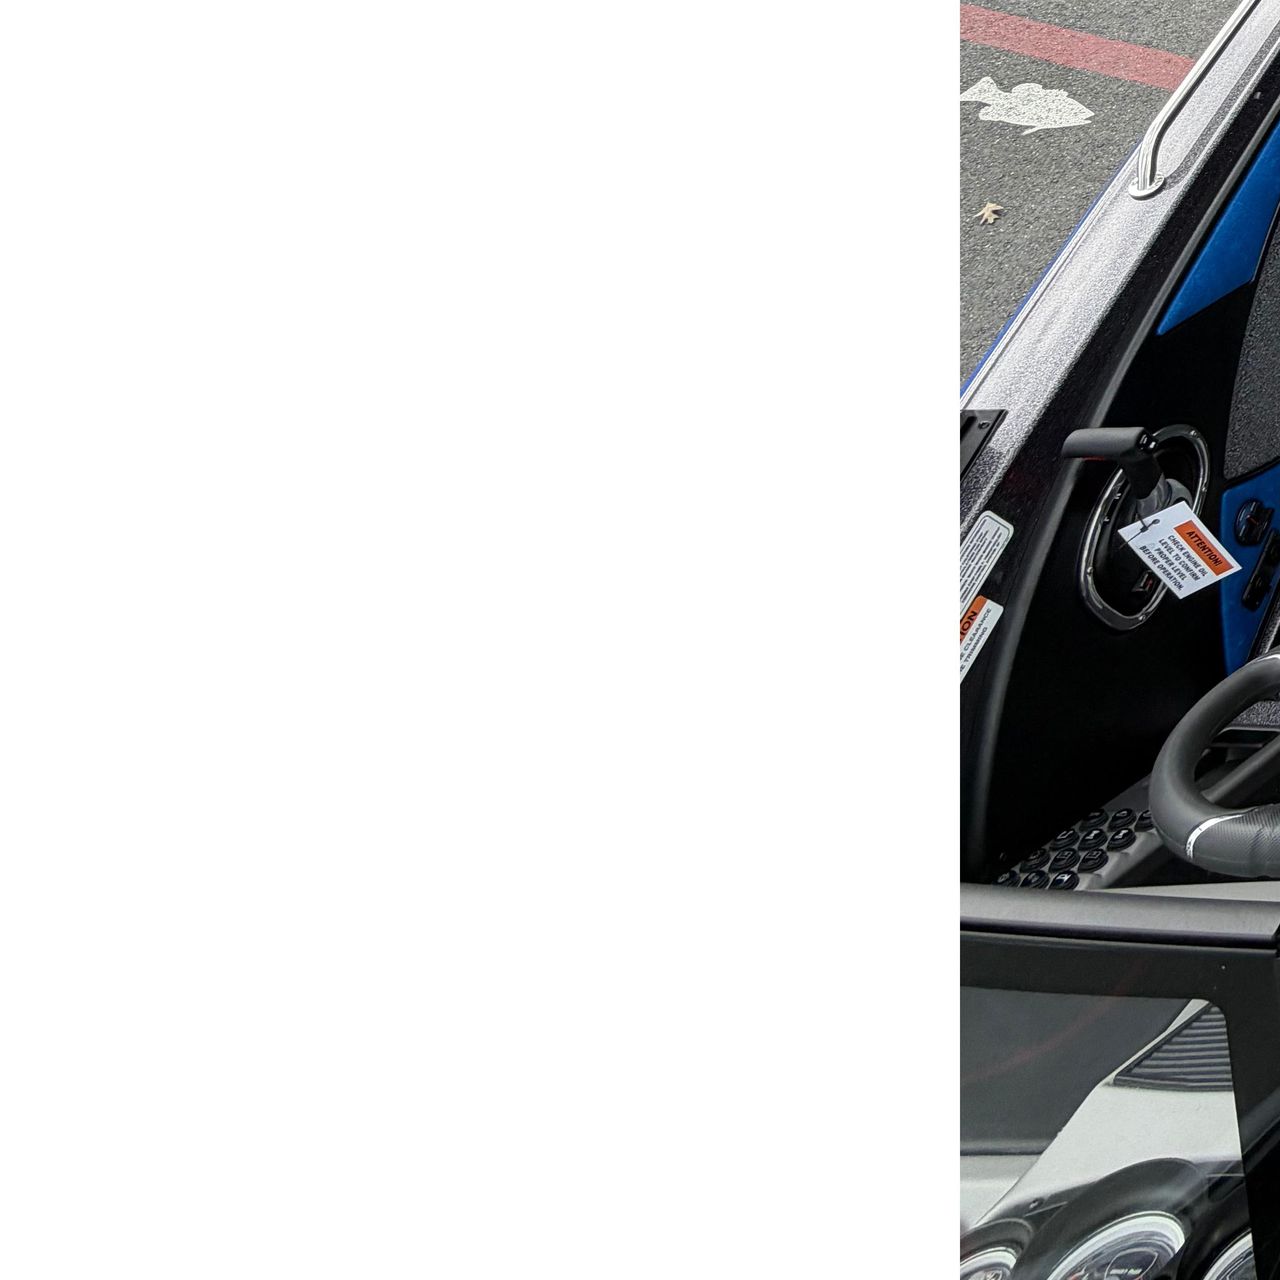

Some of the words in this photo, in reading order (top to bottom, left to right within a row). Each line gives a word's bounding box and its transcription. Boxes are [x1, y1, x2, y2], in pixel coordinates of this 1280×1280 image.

[1139, 545, 1161, 566] BEFORE
[1157, 563, 1185, 591] OPERATION.
[1154, 548, 1173, 567] PROPER
[1171, 565, 1188, 581] LEVEL
[1158, 538, 1174, 555] LEVEL
[1172, 552, 1182, 562] TO
[1178, 560, 1201, 582] CONFIRM
[1168, 534, 1186, 553] CHECK
[1182, 550, 1201, 569] ENGINE
[1198, 567, 1208, 577] OIL
[1186, 530, 1223, 567] ATTENTION!
